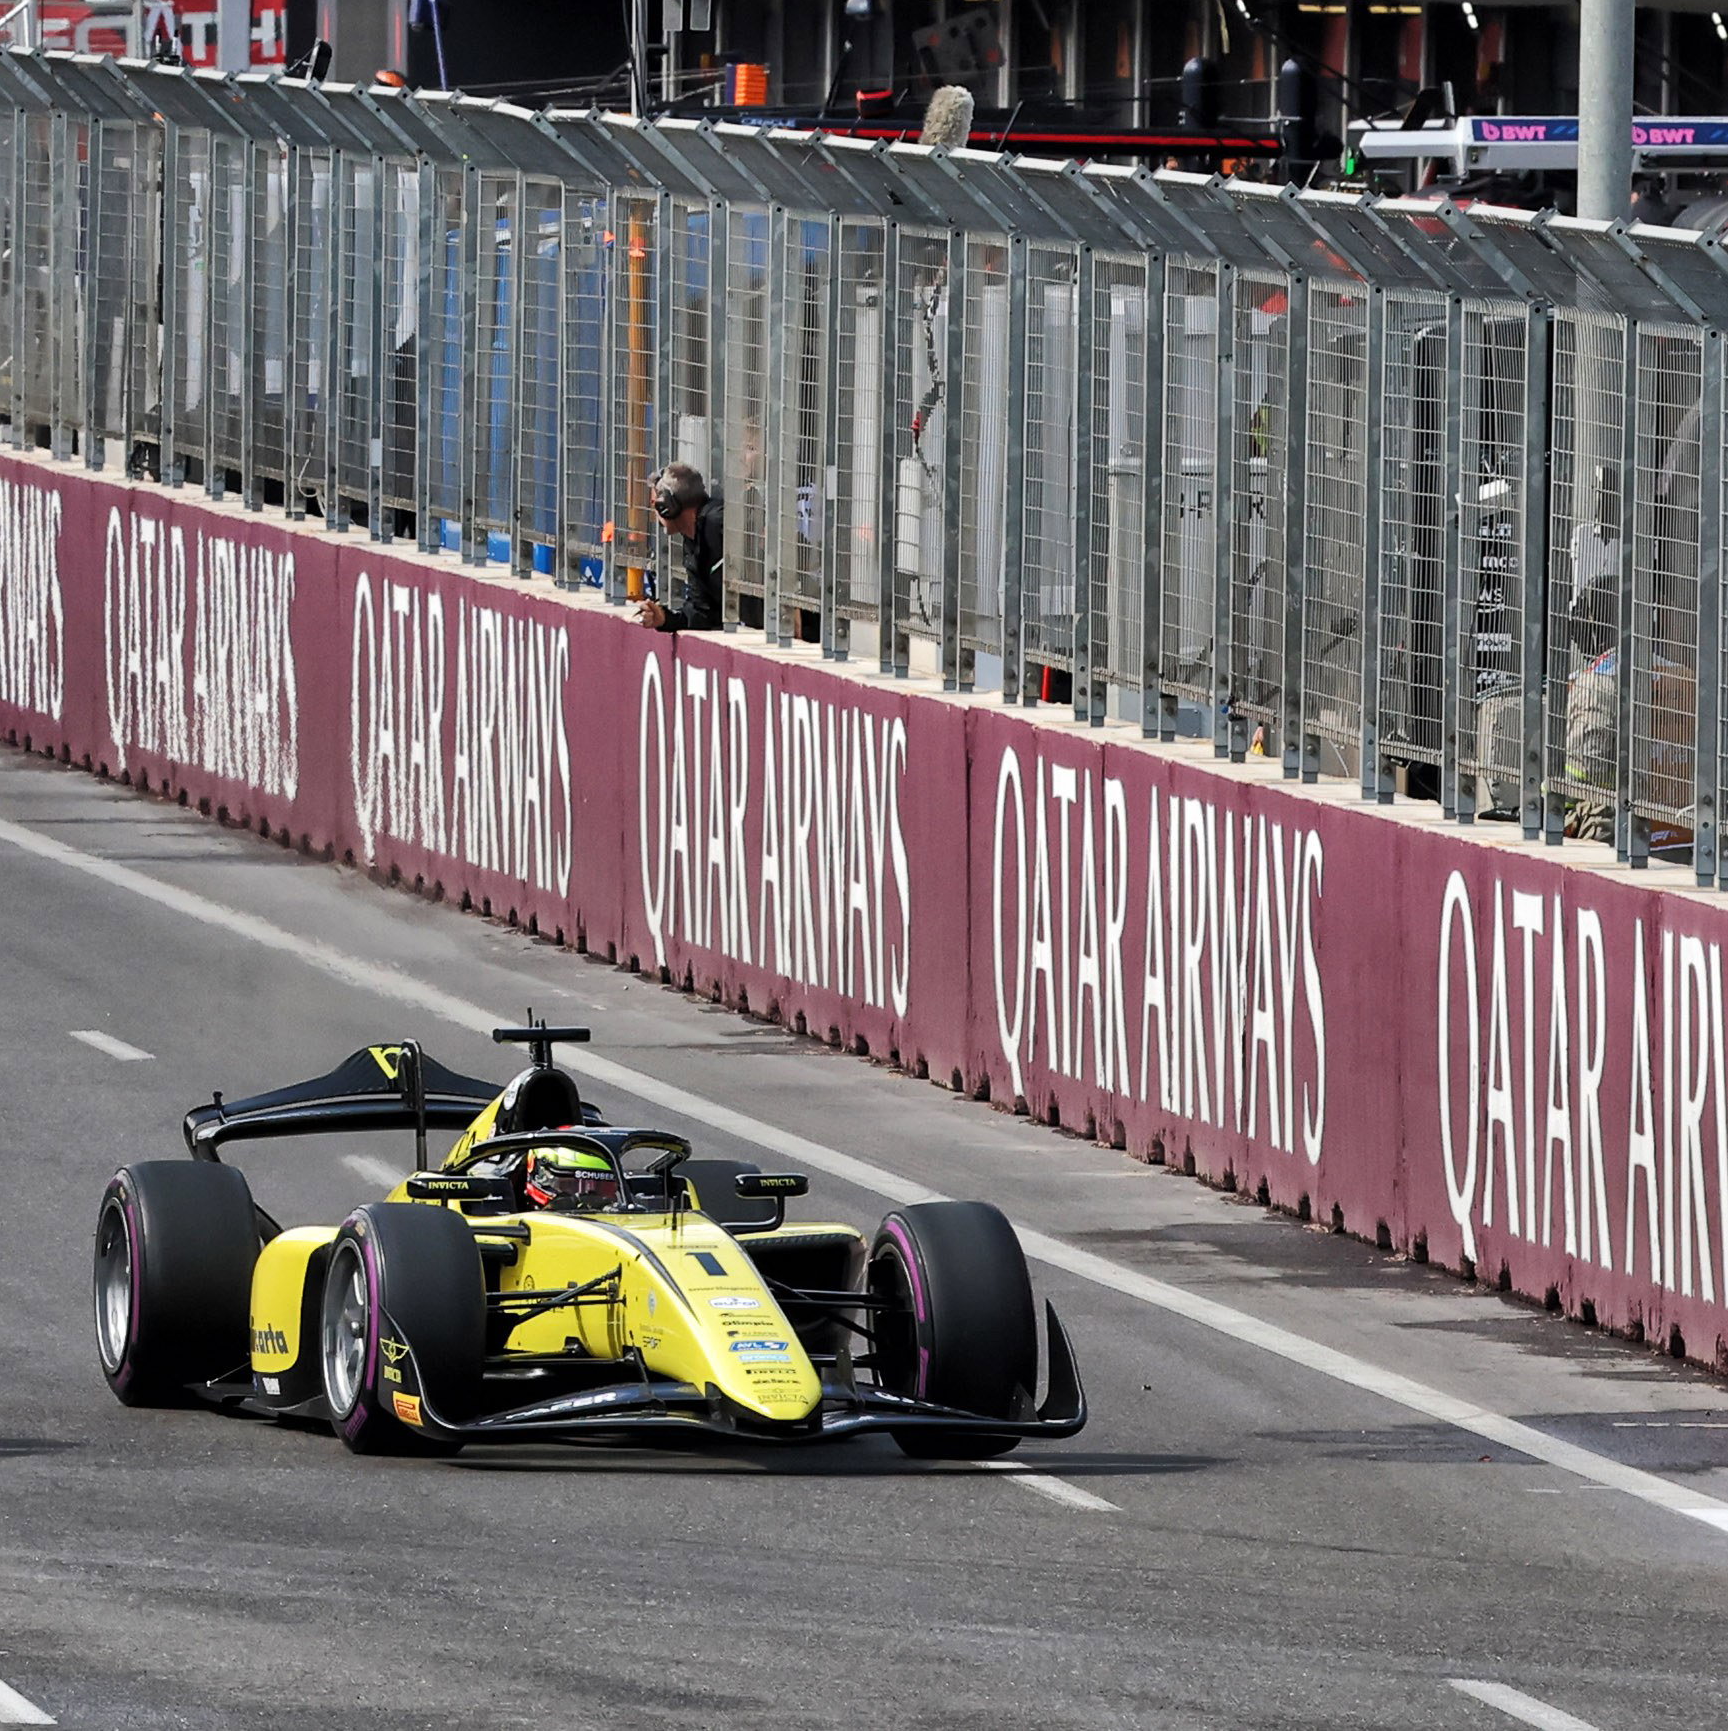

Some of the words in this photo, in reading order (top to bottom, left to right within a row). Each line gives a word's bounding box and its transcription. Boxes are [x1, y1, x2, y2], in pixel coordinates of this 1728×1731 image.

[1501, 124, 1547, 141] BWT
[1649, 127, 1695, 144] BWT
[349, 571, 446, 866] QATAR
[451, 596, 573, 900] AIRWAYS
[639, 650, 752, 969] QATAR
[759, 681, 911, 1019] AIRWAYS
[992, 745, 1130, 1099] QATAR
[1139, 784, 1327, 1166] AIRWAYS
[1437, 869, 1613, 1265] QATAR
[427, 1180, 470, 1190] INVICTA
[574, 1169, 615, 1181] SCHUBER
[759, 1178, 797, 1187] INVICTA
[685, 1252, 729, 1277] 1
